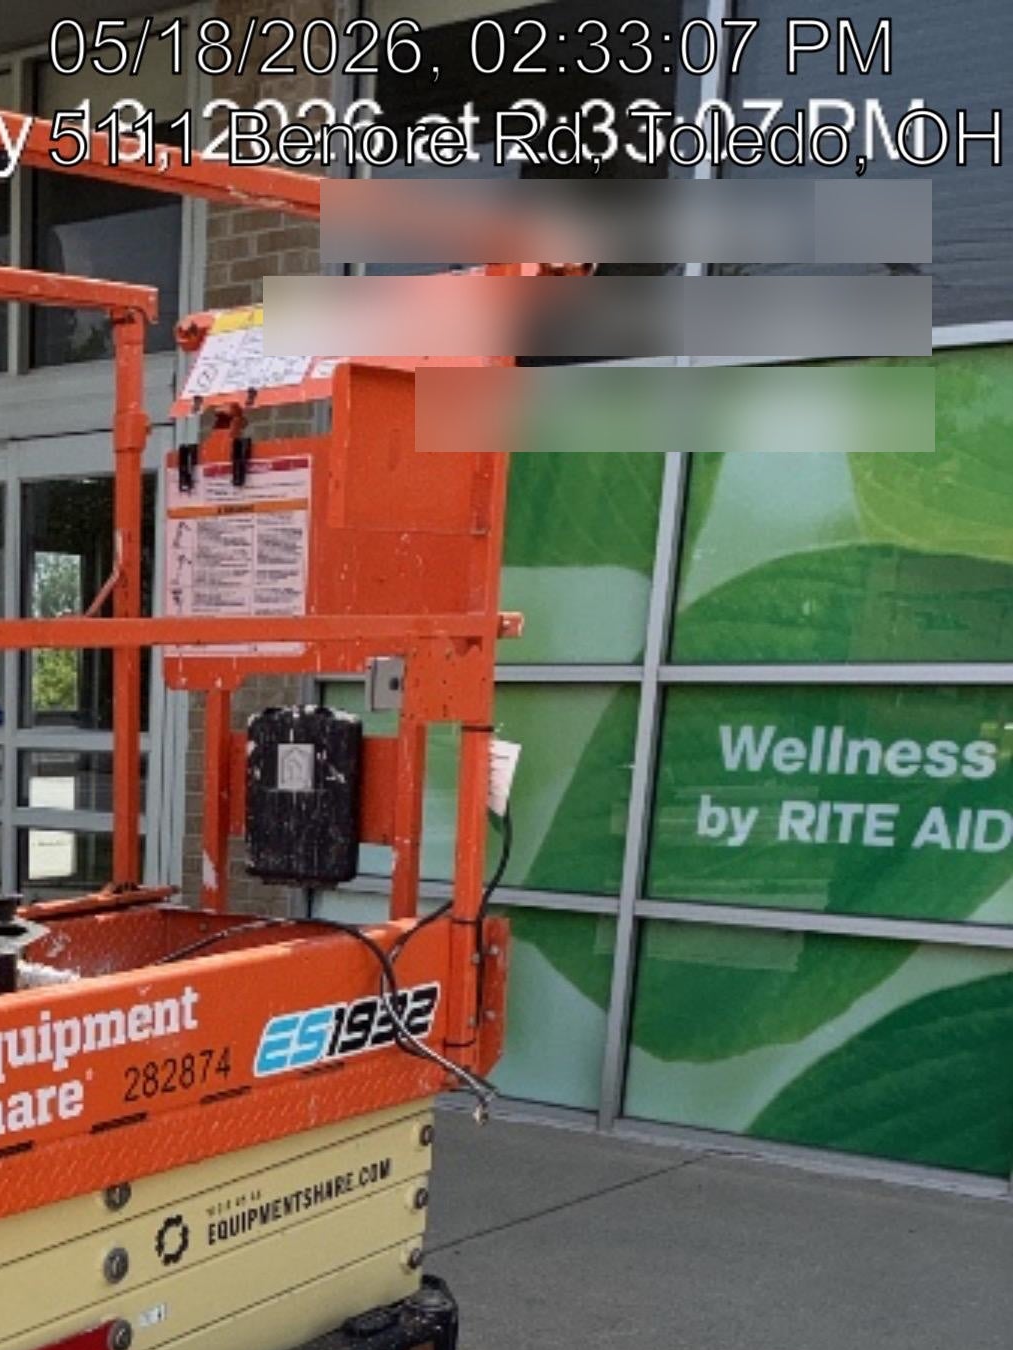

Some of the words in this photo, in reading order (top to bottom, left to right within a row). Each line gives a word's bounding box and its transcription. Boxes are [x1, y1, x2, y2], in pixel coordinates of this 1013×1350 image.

[718, 724, 998, 780] Wellness
[696, 794, 760, 847] by
[778, 799, 900, 848] RITE
[911, 805, 1013, 853] AID
[123, 1046, 232, 1103] 282874
